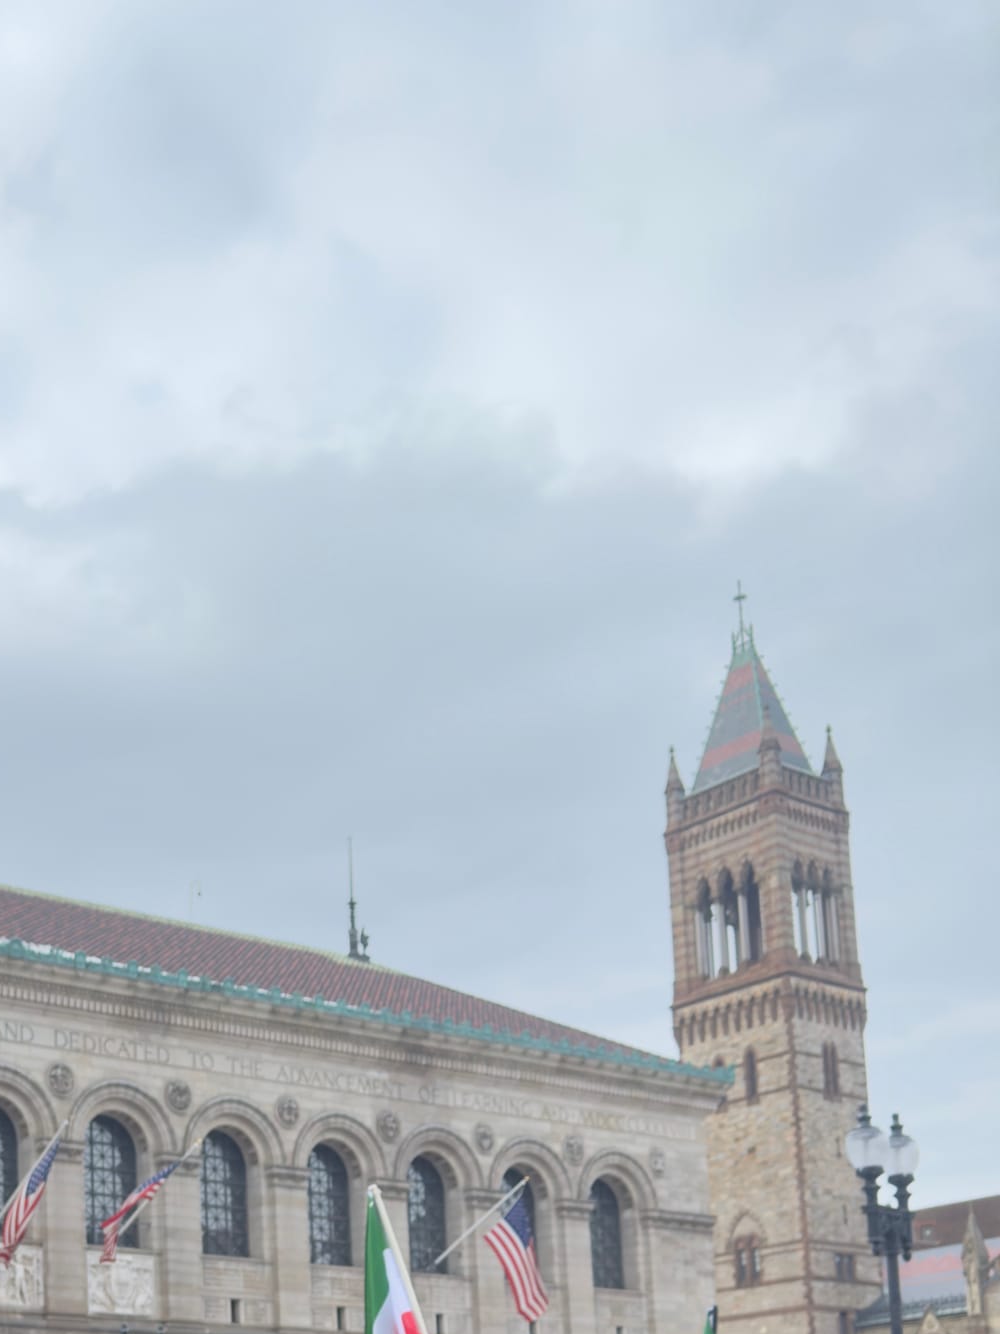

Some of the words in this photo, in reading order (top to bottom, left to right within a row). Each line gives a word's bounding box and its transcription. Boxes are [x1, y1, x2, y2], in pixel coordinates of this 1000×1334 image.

[53, 1030, 171, 1065] DEDICATED
[189, 1051, 214, 1070] TO
[226, 1055, 262, 1079] THE
